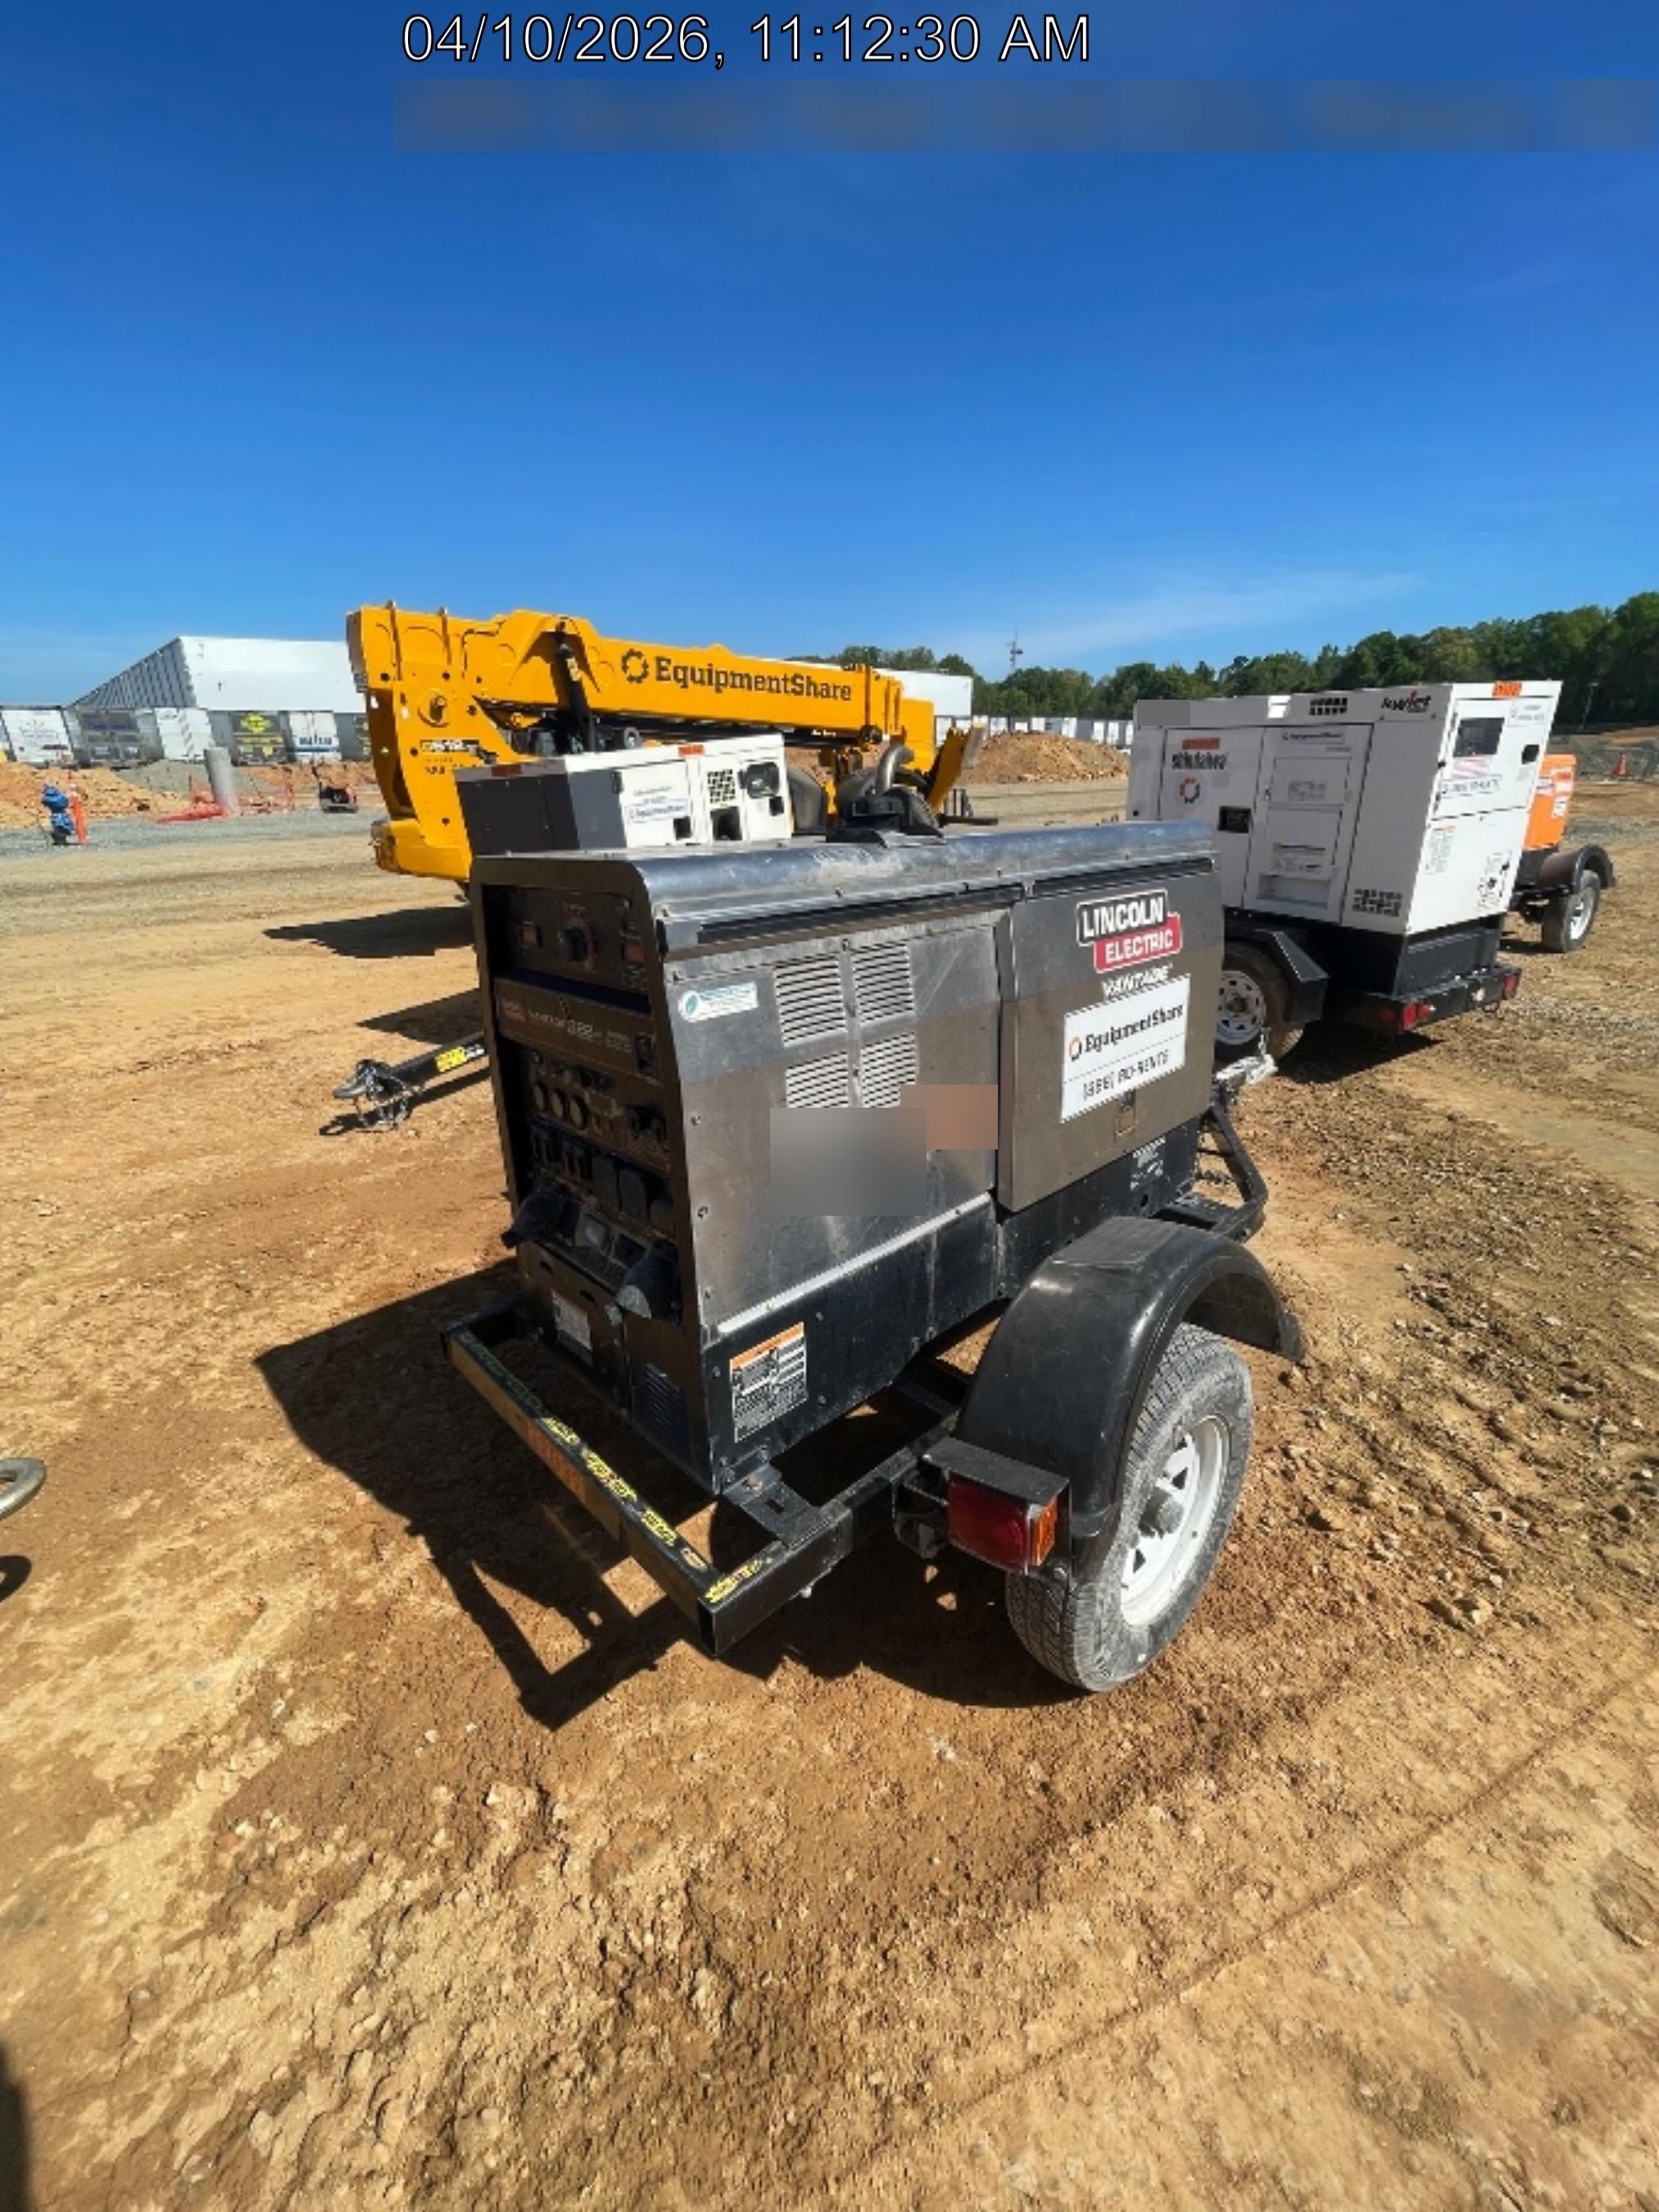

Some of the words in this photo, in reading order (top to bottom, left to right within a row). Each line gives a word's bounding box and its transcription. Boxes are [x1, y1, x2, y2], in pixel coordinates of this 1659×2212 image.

[655, 656, 851, 700] EquipmentShare
[1083, 896, 1164, 938] LINCOLN
[1106, 929, 1173, 964] ELECTRIC
